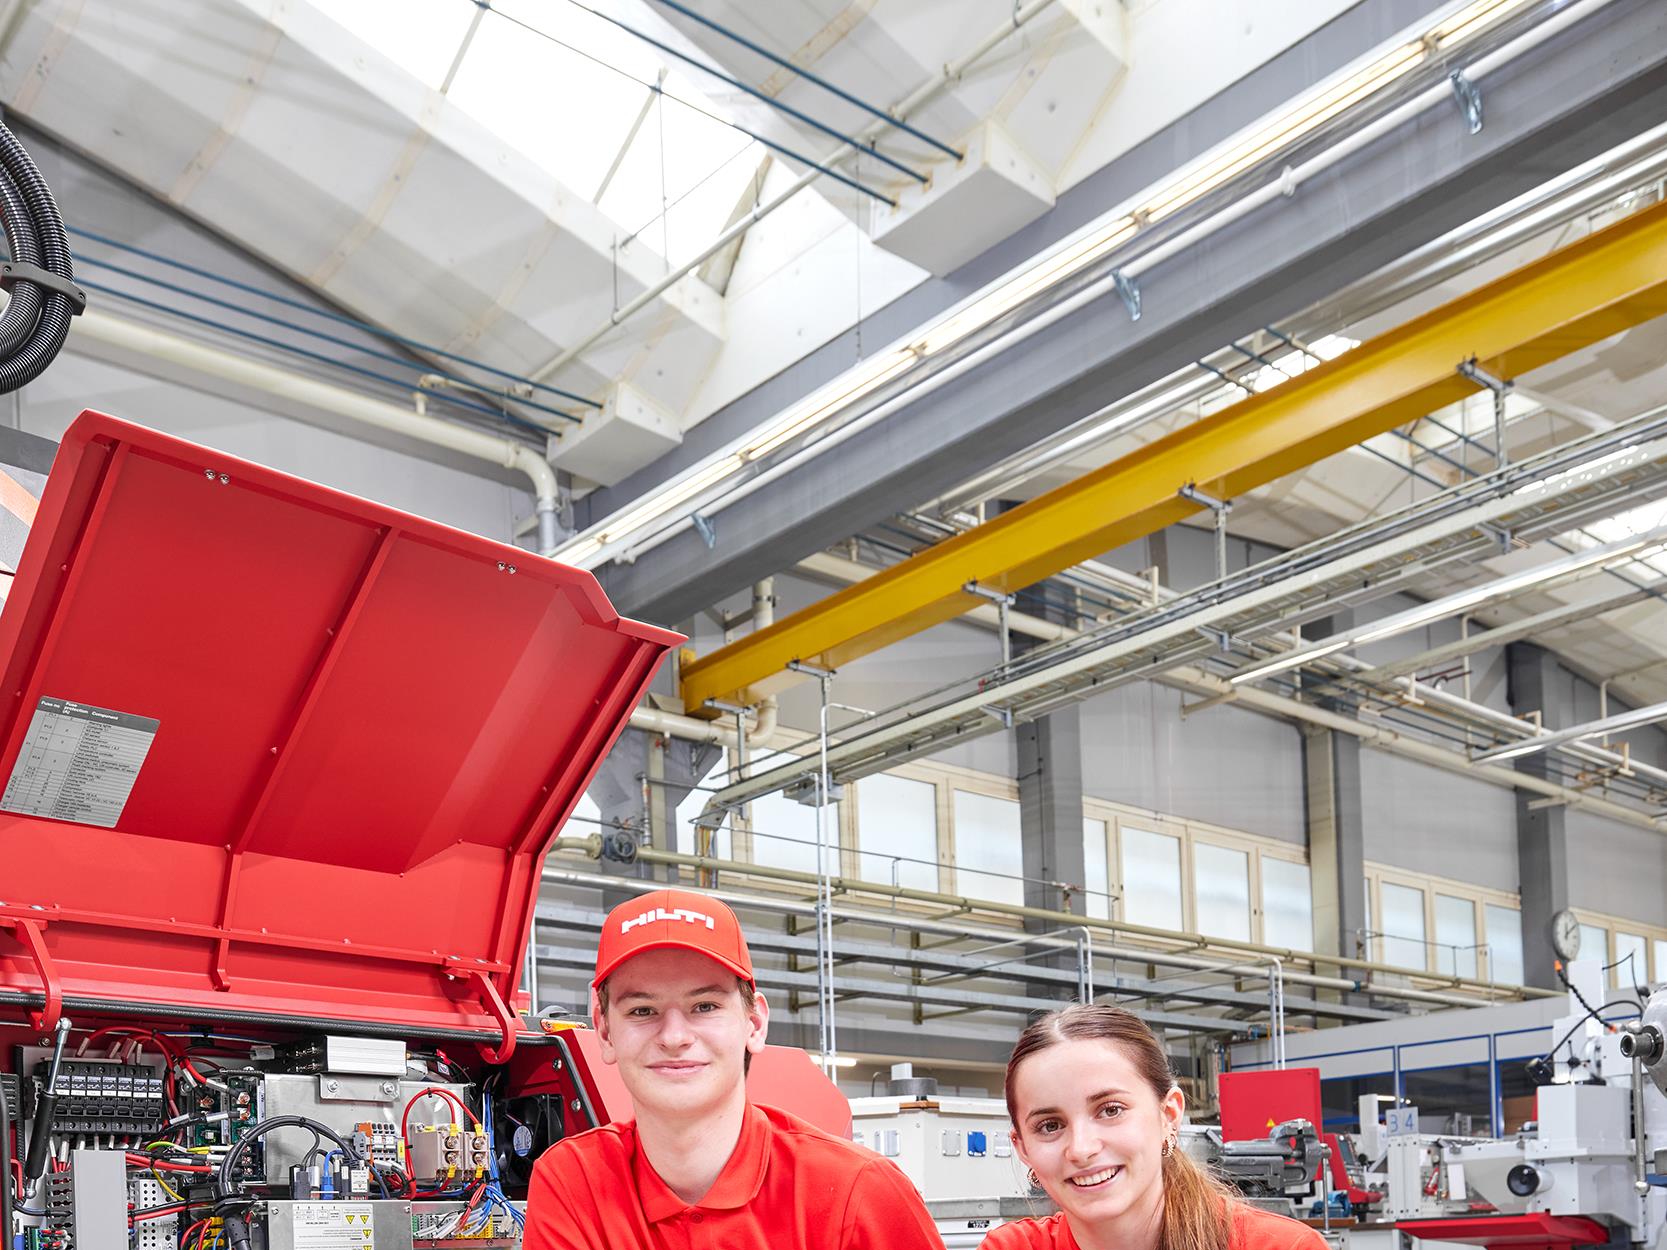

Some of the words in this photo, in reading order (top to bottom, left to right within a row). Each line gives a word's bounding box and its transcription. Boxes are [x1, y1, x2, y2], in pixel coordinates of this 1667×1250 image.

[63, 706, 89, 715] protection
[91, 711, 119, 720] Component
[622, 908, 715, 934] HILTI
[1404, 1112, 1414, 1131] 4
